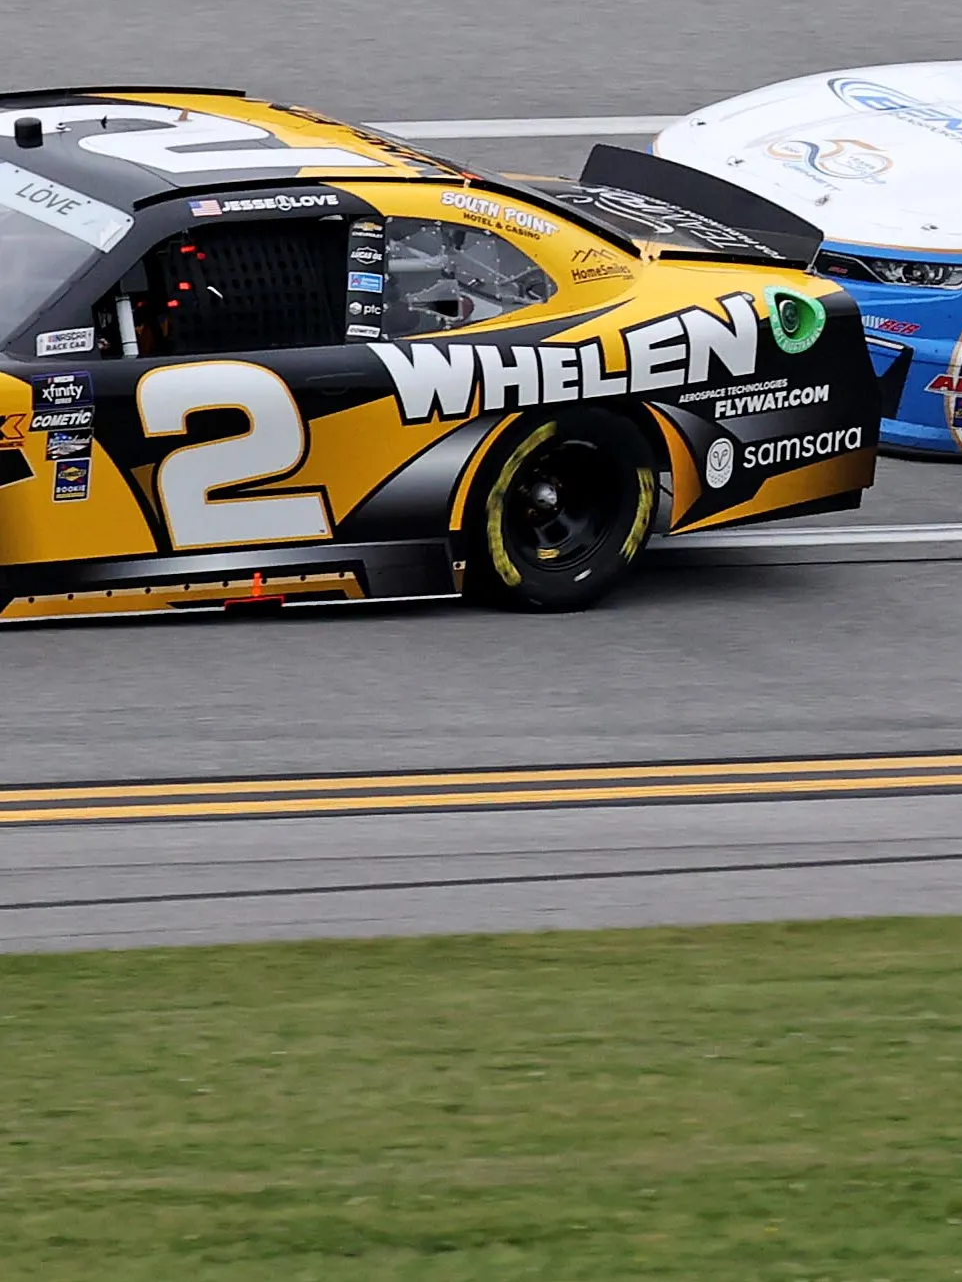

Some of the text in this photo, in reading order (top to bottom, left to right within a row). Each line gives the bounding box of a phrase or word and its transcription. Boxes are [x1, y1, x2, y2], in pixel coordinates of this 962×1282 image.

[15, 183, 81, 216] LOVE
[222, 194, 339, 212] JESSE LOVE
[441, 191, 559, 236] SOUTH POINT
[463, 212, 494, 227] HOTEL
[505, 224, 541, 240] CASINO
[46, 340, 87, 351] RACE CAR
[367, 294, 759, 419] WHELEN
[42, 384, 84, 402] xfinity
[678, 378, 788, 404] AEROSPACE TECHNOLOGIES
[714, 384, 830, 418] FLYWAT.COM
[136, 360, 333, 551] 2
[742, 426, 863, 469] samsara
[56, 485, 87, 494] ROOKIE
